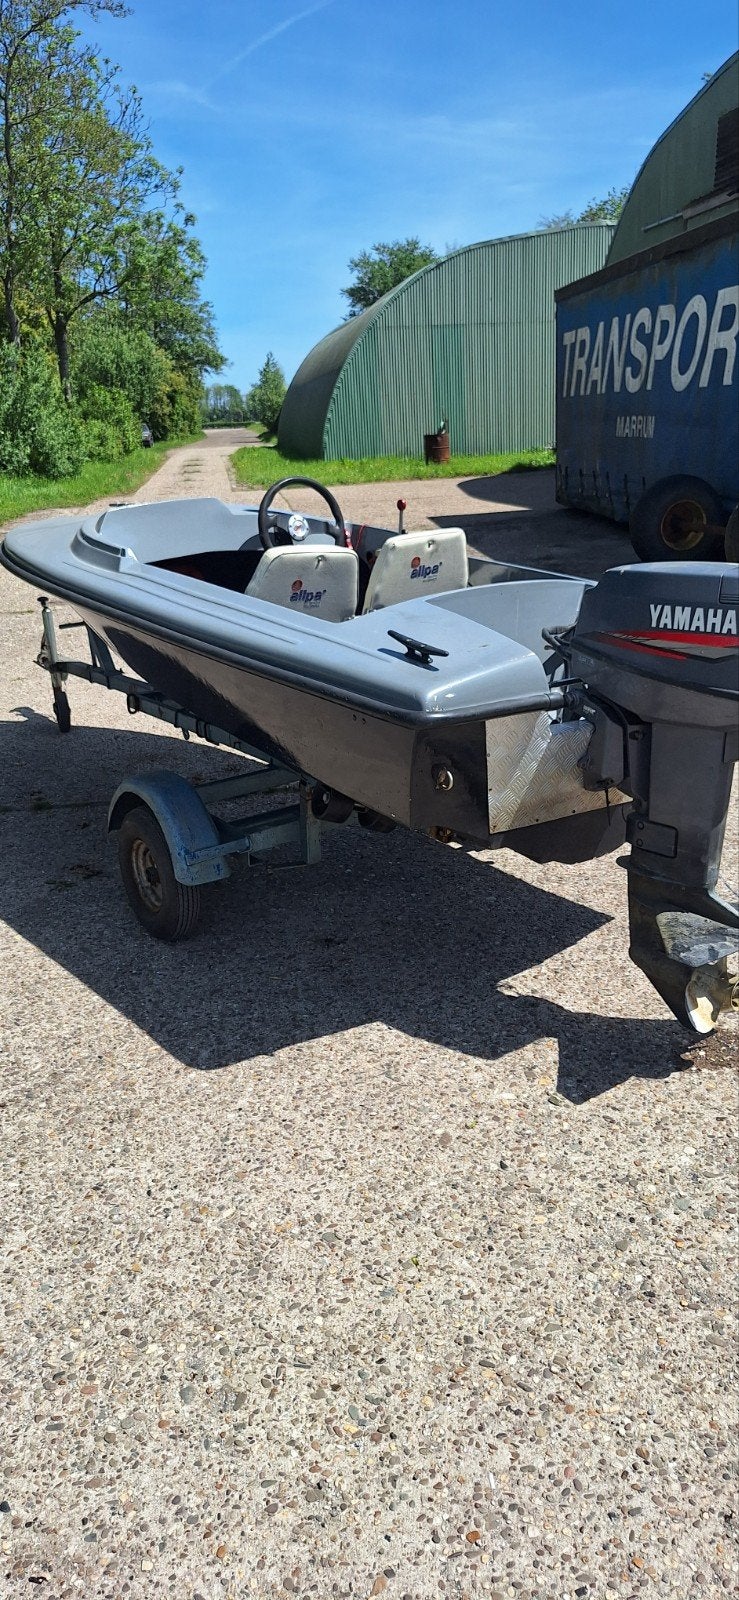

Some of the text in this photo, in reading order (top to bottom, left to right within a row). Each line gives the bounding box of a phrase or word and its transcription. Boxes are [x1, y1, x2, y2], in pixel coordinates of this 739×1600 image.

[562, 284, 738, 398] TRANSPOR
[615, 414, 656, 439] MARRUM
[649, 603, 737, 635] YAMAHA
